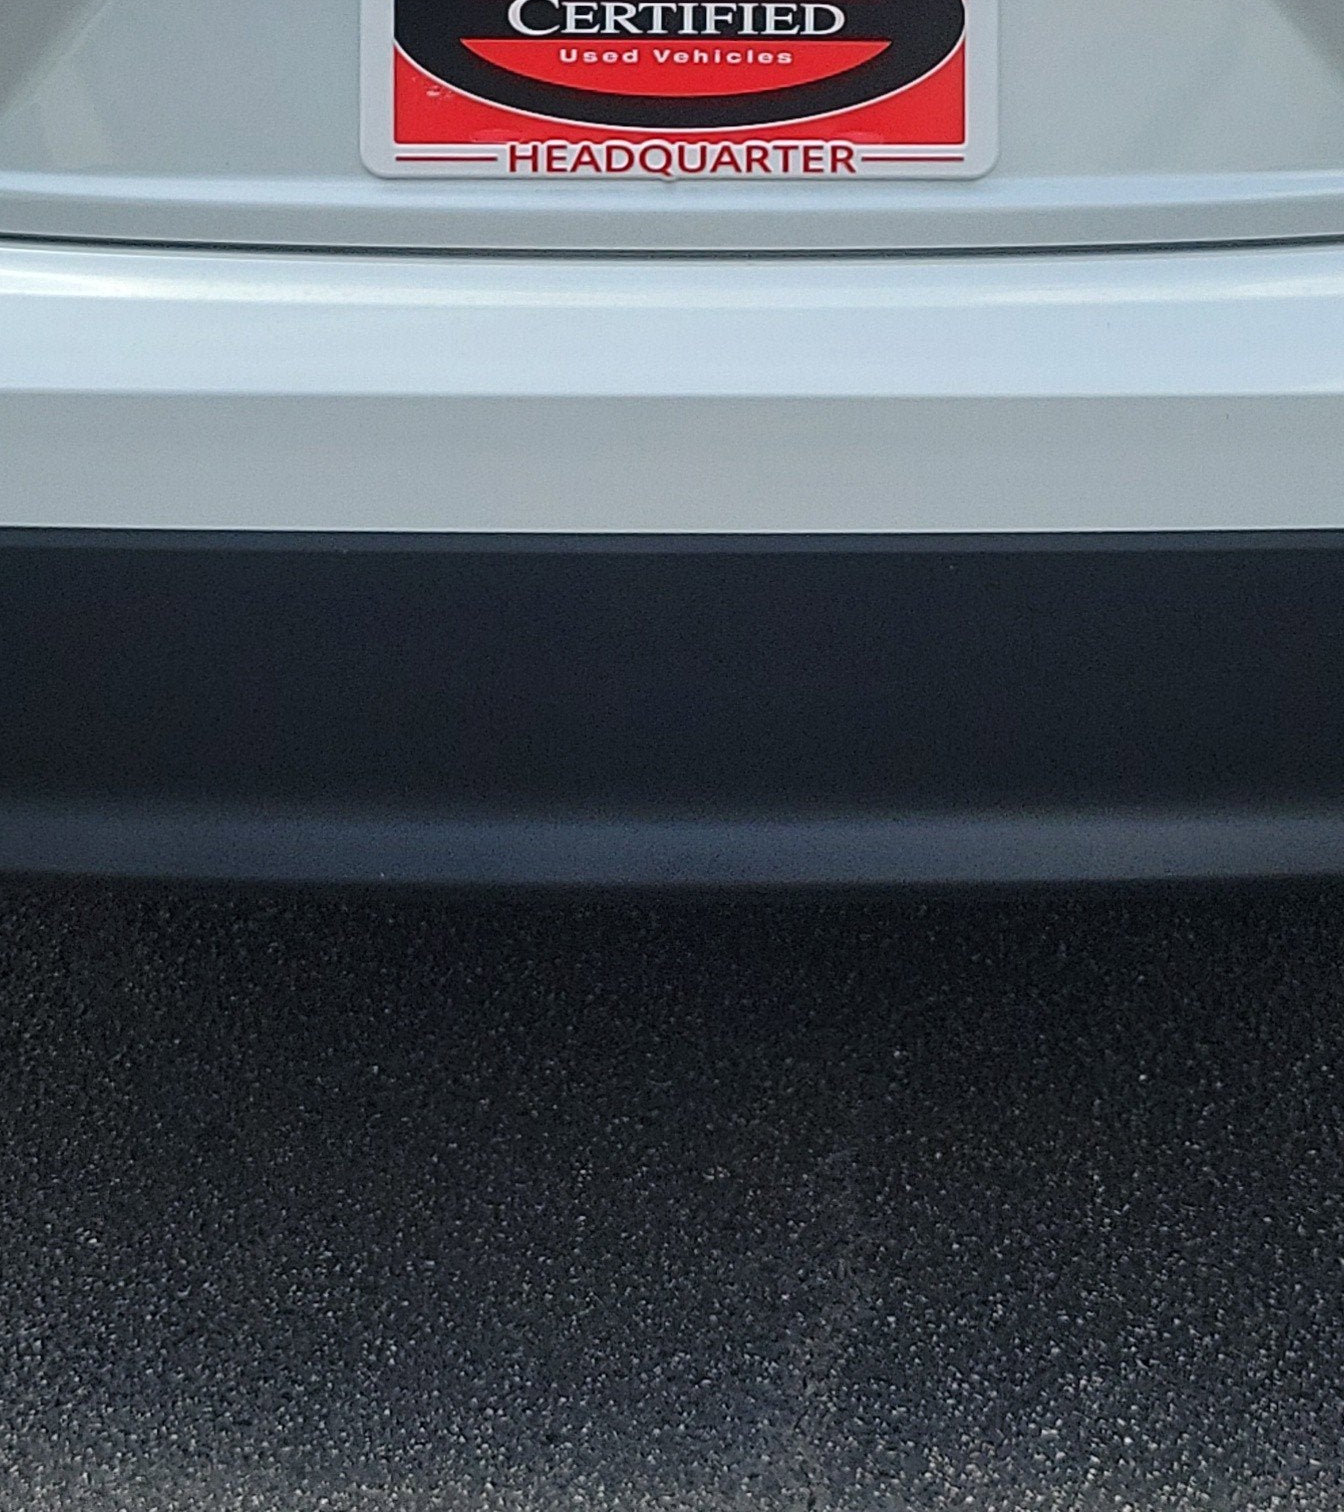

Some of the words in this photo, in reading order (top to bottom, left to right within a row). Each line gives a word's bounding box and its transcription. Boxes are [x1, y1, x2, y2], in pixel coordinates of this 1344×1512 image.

[559, 47, 639, 65] Used
[652, 47, 794, 65] Vehicles
[508, 143, 857, 178] HEADQUARTER
